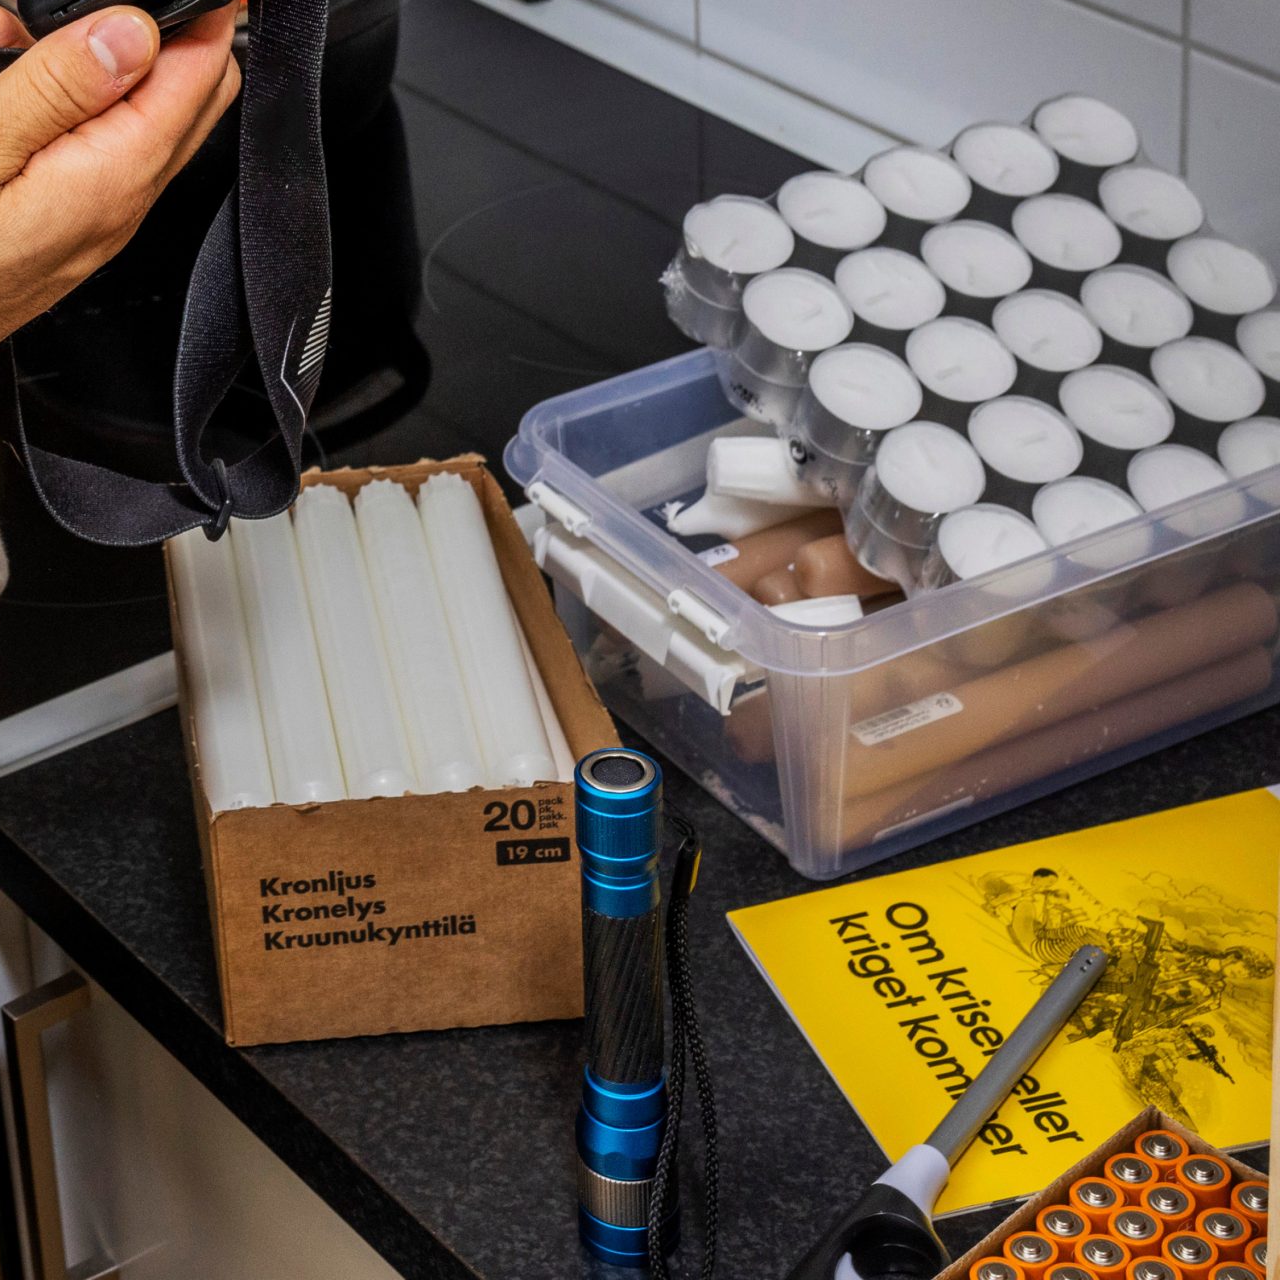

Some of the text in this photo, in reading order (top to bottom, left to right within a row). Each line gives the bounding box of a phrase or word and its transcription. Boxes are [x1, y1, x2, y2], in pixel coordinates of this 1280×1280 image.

[538, 796, 564, 807] pack
[483, 799, 536, 832] 20
[538, 813, 567, 823] pakk.
[538, 821, 559, 831] pak
[506, 845, 562, 860] 19 cm
[259, 870, 377, 897] Kronljus
[261, 896, 387, 924] Kronelys
[264, 914, 477, 951] Kruunukynttilä
[828, 911, 1029, 1156] kriget komer
[885, 902, 1085, 1143] Om krise eller
